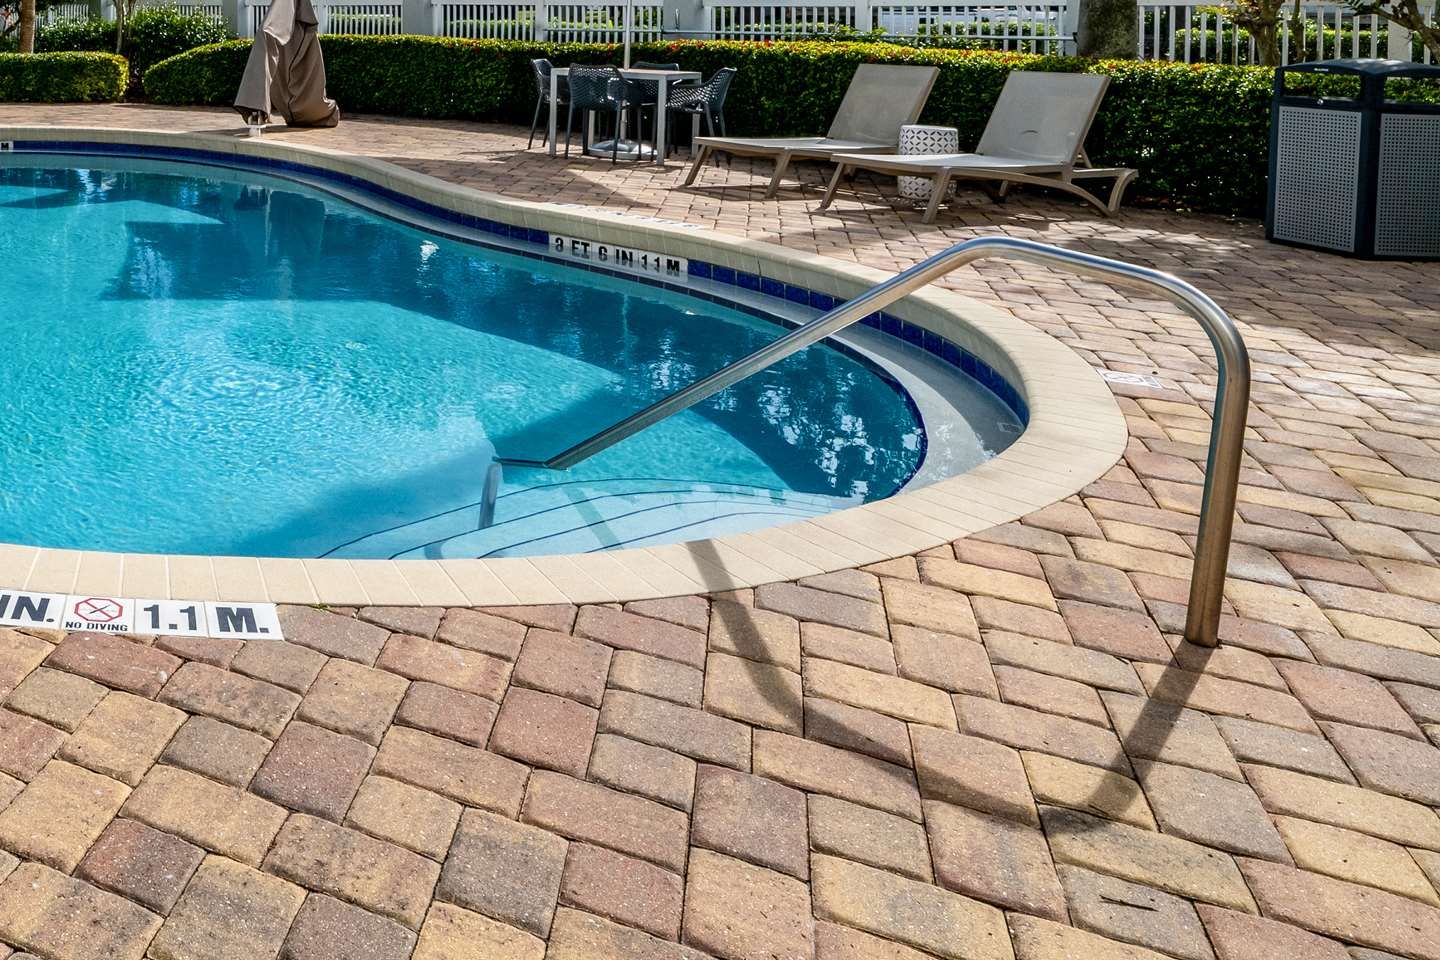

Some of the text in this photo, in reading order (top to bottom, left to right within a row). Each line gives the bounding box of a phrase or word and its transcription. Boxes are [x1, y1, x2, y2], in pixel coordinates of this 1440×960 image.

[1, 142, 9, 151] M
[572, 240, 590, 252] FT
[616, 249, 633, 261] IN
[667, 259, 680, 272] M
[65, 621, 129, 632] NO DIVING
[143, 604, 198, 631] 1.1
[215, 606, 270, 634] M.
